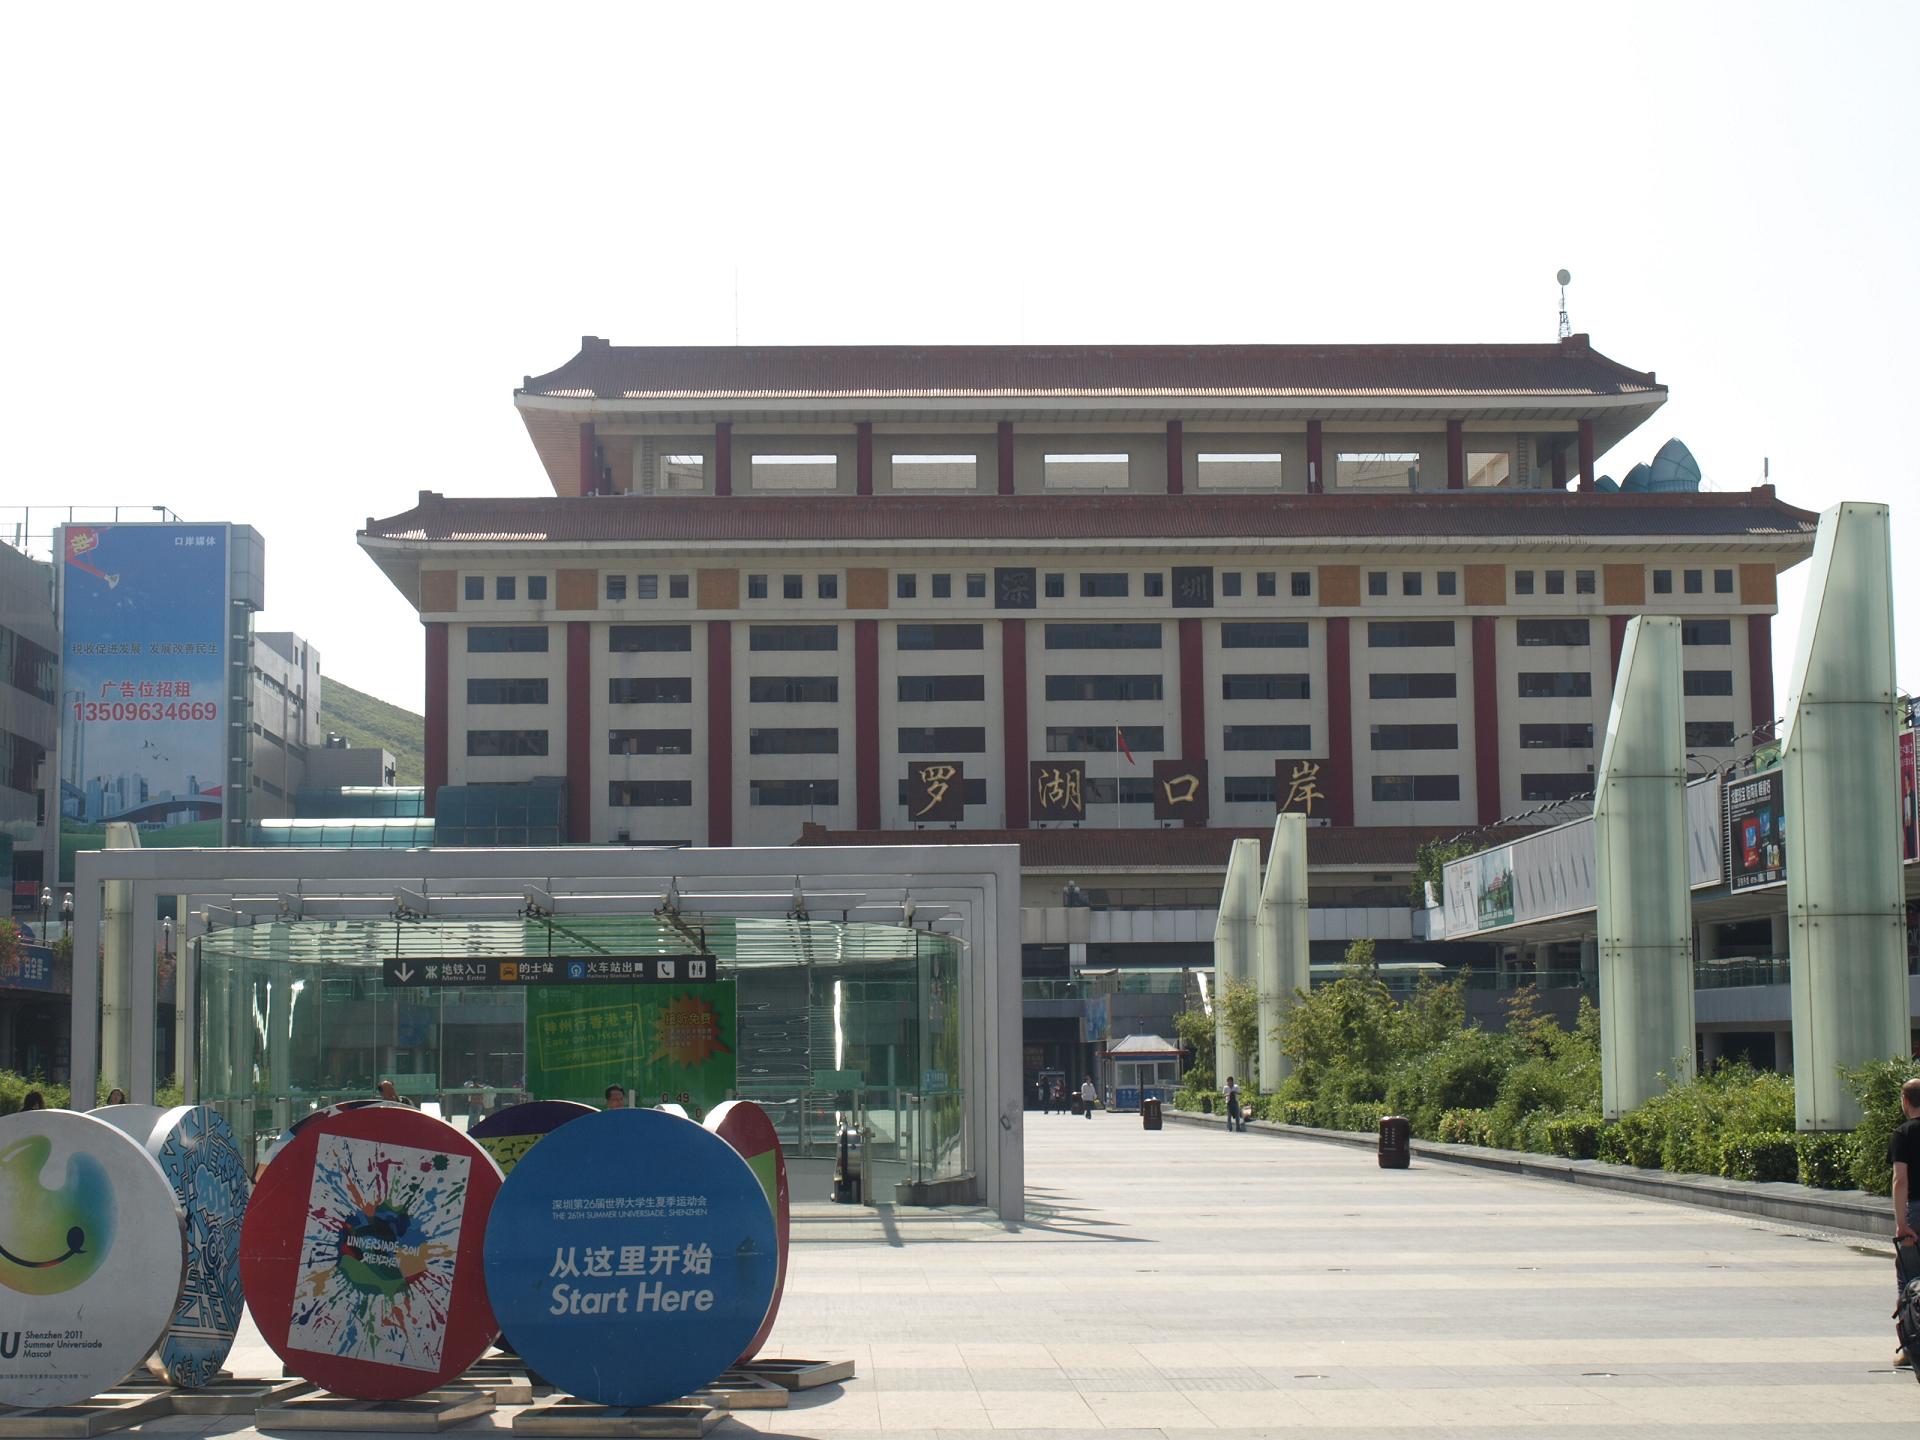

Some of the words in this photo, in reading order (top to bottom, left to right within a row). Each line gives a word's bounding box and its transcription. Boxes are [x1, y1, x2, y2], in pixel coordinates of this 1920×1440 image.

[101, 681, 192, 698] 广告位招租
[74, 702, 217, 722] 13509634669
[916, 760, 1326, 816] 罗湖口岸
[441, 963, 487, 975] 地铁入口
[519, 962, 554, 974] 的士站
[587, 962, 644, 974] 火车站出口
[552, 1196, 708, 1211] 深圳第26届世界大学生夏季运动会
[552, 1212, 566, 1220] THE
[567, 1211, 585, 1219] 26TH
[586, 1210, 617, 1219] SUMMER
[668, 1208, 708, 1217] SHENZHEN
[346, 1235, 400, 1253] UNIVERSIADE
[401, 1244, 421, 1257] 2011
[549, 1243, 713, 1279] 从这里开始
[550, 1283, 629, 1316] Start
[636, 1281, 714, 1312] Here
[25, 1331, 62, 1339] Shenzhen
[65, 1331, 83, 1339] 2011
[24, 1341, 55, 1349] Summer
[57, 1340, 103, 1348] Universiade
[23, 1350, 52, 1358] Mascot
